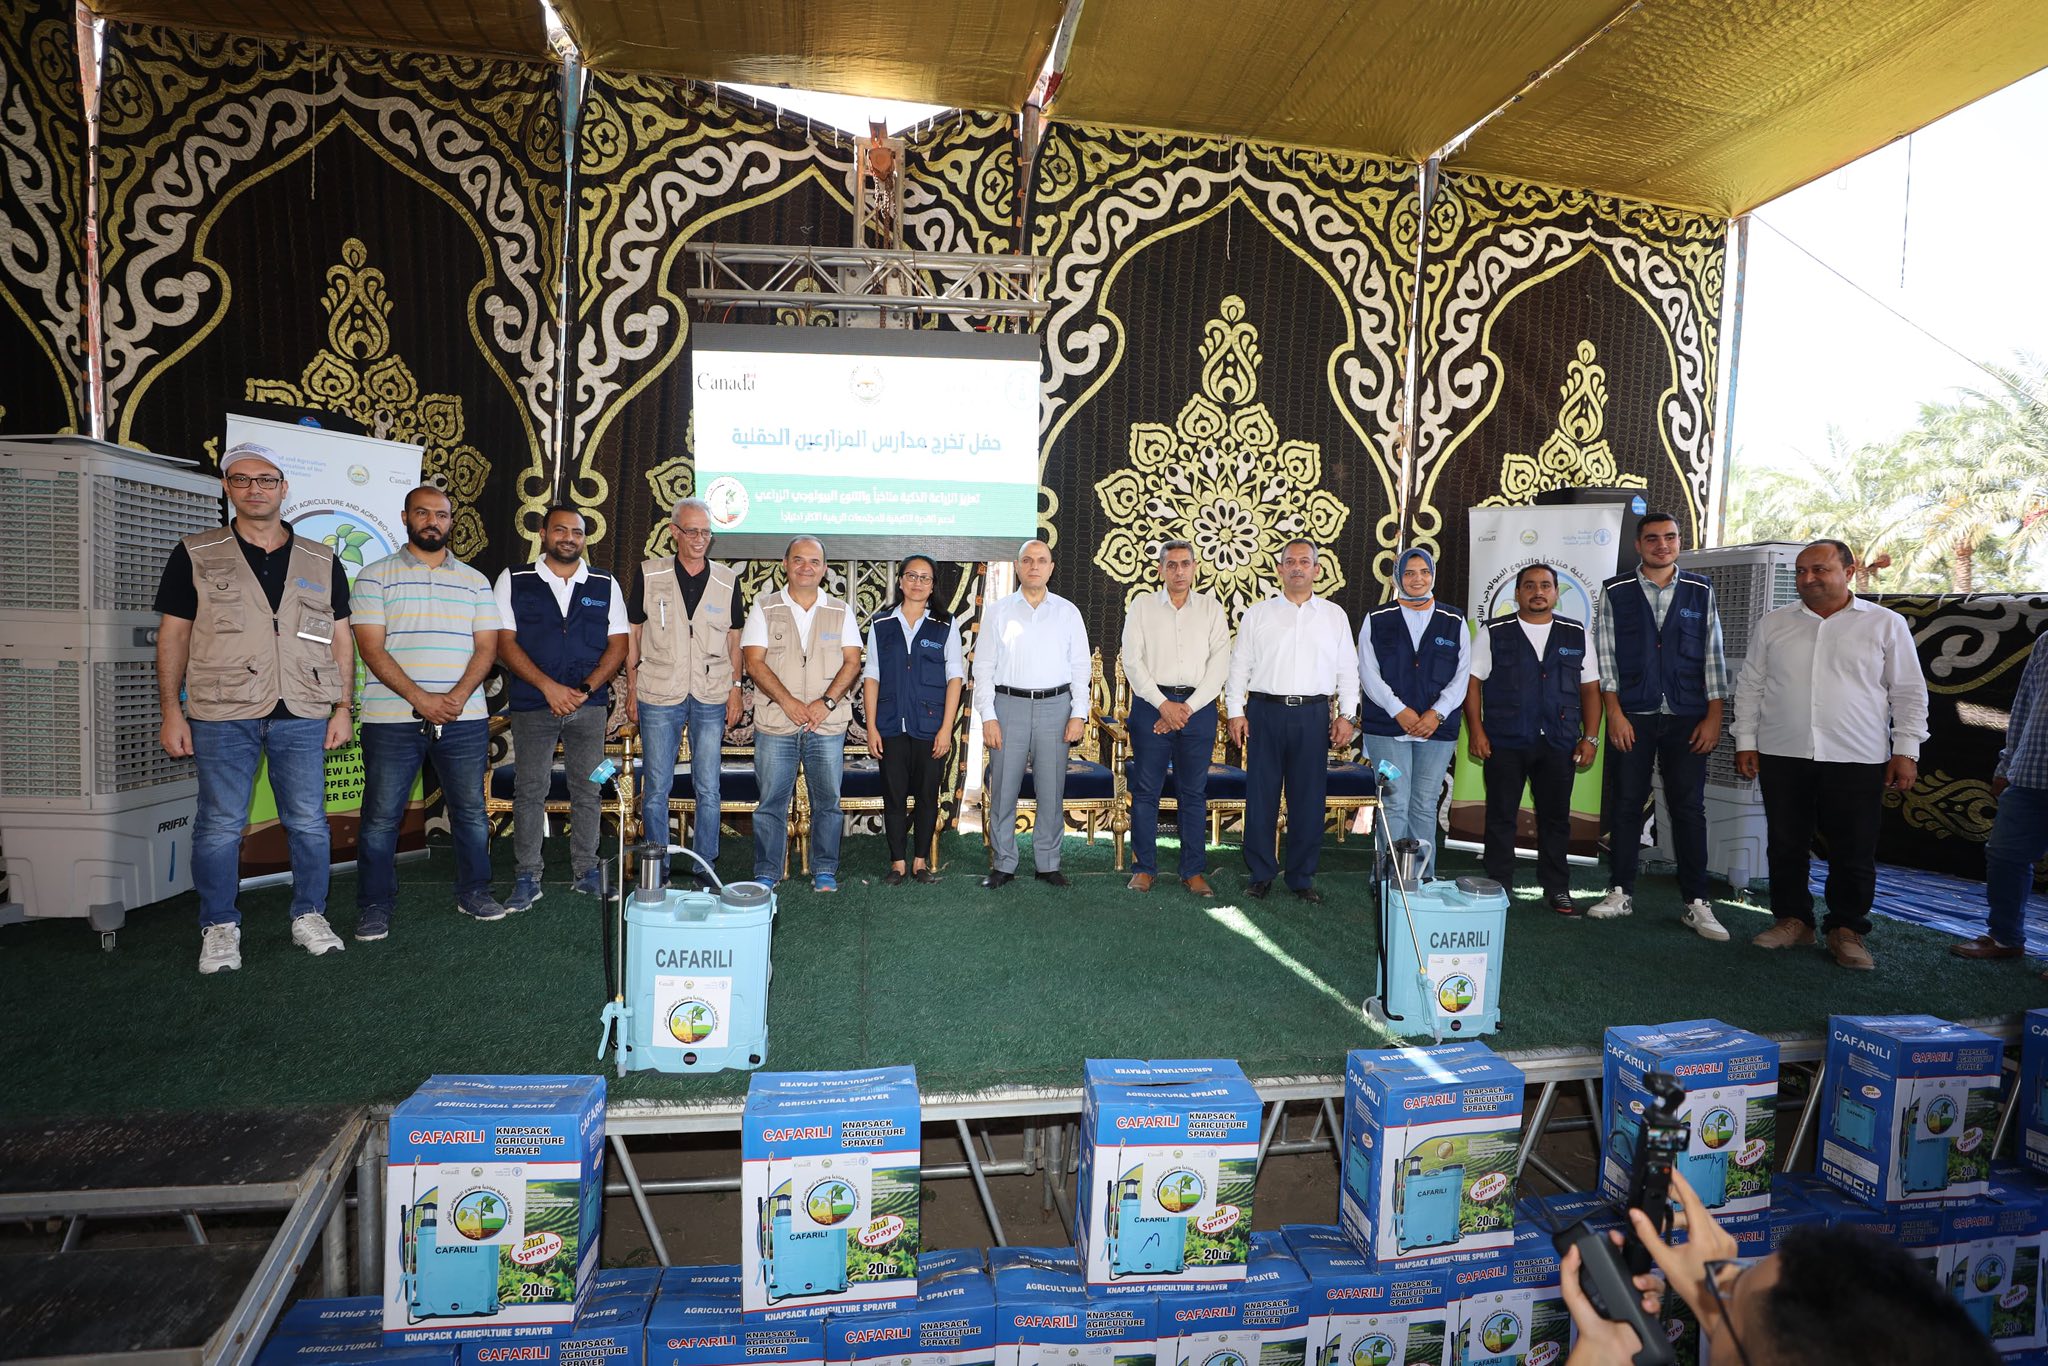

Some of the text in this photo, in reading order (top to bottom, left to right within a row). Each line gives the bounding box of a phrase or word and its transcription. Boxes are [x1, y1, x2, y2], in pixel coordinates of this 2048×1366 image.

[697, 371, 757, 391] Canada
[732, 427, 1001, 455] حفل تخرج مدارس المزارعين الحقلية
[299, 499, 344, 509] AGRICULTURE
[345, 502, 361, 512] AND
[360, 509, 379, 523] AGRO
[324, 766, 343, 777] EW
[324, 780, 350, 789] PPER
[157, 816, 189, 834] PRIFIX
[1430, 930, 1490, 949] CAFARILI
[655, 948, 733, 969] CAFARILI
[1834, 1030, 1891, 1060] CAFARILI
[1606, 1042, 1652, 1073] CAFARILI
[1728, 1055, 1764, 1065] KNAPSACK
[1675, 1062, 1724, 1077] CAFARILI
[1728, 1062, 1771, 1073] AGRICULTURE
[1727, 1071, 1757, 1081] SPRAYER
[1191, 1088, 1229, 1098] SPRAYER
[1349, 1069, 1381, 1107] CAFARILI
[1463, 1086, 1505, 1096] KNAPSACK
[434, 1101, 510, 1109] AGRICULTURAL
[778, 1093, 890, 1108] AGRICULTURAL SPRAYER
[1404, 1093, 1457, 1110] CAFARILI
[1463, 1093, 1514, 1105] AGRICULTURE
[1463, 1104, 1498, 1113] SPRAYER
[1116, 1115, 1180, 1129] CAFARILI
[1188, 1112, 1237, 1121] KNAPSACK
[842, 1119, 894, 1129] KNAPSACK
[1188, 1121, 1248, 1130] AGRICULTURE
[409, 1129, 486, 1145] CAFARILI
[495, 1126, 552, 1137] KNAPSACK
[763, 1126, 833, 1142] CAFARILI
[841, 1127, 906, 1139] AGRICULTURE
[1187, 1130, 1228, 1139] SPRAYER
[494, 1135, 566, 1146] AGRICULTURE
[841, 1138, 884, 1148] SPRAYER
[494, 1146, 541, 1156] SPRAYER
[1738, 1145, 1766, 1164] Sprayer
[1417, 1188, 1448, 1198] CAFARILI
[1474, 1179, 1506, 1199] Sprayer
[1826, 1175, 1843, 1189] MADE
[1850, 1188, 1869, 1202] CHINA
[1202, 1211, 1239, 1231] Sprayer
[1477, 1215, 1500, 1228] 20Ltr
[1736, 1213, 1760, 1223] SPRAYER
[789, 1231, 828, 1241] CAFARILI
[864, 1223, 903, 1244] Sprayer
[435, 1245, 478, 1255] CAFARILI
[517, 1240, 561, 1262] Sprayer
[1204, 1248, 1232, 1261] 20Ltr
[918, 1258, 957, 1272] AGRICULT
[1329, 1259, 1366, 1267] AGRICULT
[1395, 1259, 1429, 1270] KNAPSACK
[1471, 1250, 1500, 1261] SPRAYER
[1513, 1257, 1554, 1268] KNAPSACK
[868, 1261, 898, 1276] 20Ltr
[1456, 1265, 1508, 1284] CAFARILI
[1391, 1279, 1433, 1290] KNAPSACK
[1513, 1274, 1548, 1284] SPRAYER
[521, 1282, 555, 1299] 20Ltr
[926, 1288, 965, 1301] SPRAYER
[1106, 1283, 1228, 1294] KNAPSACK AGRICULTURE SPRAYER
[1327, 1287, 1384, 1300] CAFARILI
[1390, 1287, 1442, 1299] AGRICULTURE
[1244, 1299, 1290, 1310] KNAPSACK
[1389, 1297, 1424, 1307] SPRAYER
[581, 1308, 618, 1320] PRAYER
[764, 1301, 897, 1322] KNAPSACK AGRICULTURE SPRAYER
[1086, 1310, 1134, 1320] KNAPSACK
[1175, 1306, 1237, 1322] CAFARILI
[1243, 1306, 1300, 1318] AGRICULTURE
[920, 1319, 970, 1331] KNAPSACK
[1014, 1315, 1078, 1329] CAFARILI
[1086, 1318, 1146, 1330] AGRICULTURE
[1243, 1317, 1281, 1326] SPRAYER
[404, 1326, 553, 1342] KNAPSACK AGRICULTURE SPRAYER
[745, 1330, 797, 1339] KNAPSACK
[845, 1327, 912, 1345] CAFARILI
[919, 1326, 982, 1339] AGRICULTURE
[1086, 1328, 1125, 1339] SPRAYER
[297, 1341, 378, 1354] AGRICULTURAL
[560, 1338, 615, 1350] KNAPSACK
[667, 1335, 737, 1350] CAFARILI
[745, 1337, 810, 1346] AGRICULTURE
[919, 1338, 961, 1348] SPRAYER
[478, 1346, 551, 1361] CAFARILI
[560, 1346, 629, 1361] AGRICULTURE
[745, 1346, 788, 1357] SPRAYER
[1528, 1347, 1560, 1366] Sprayer
